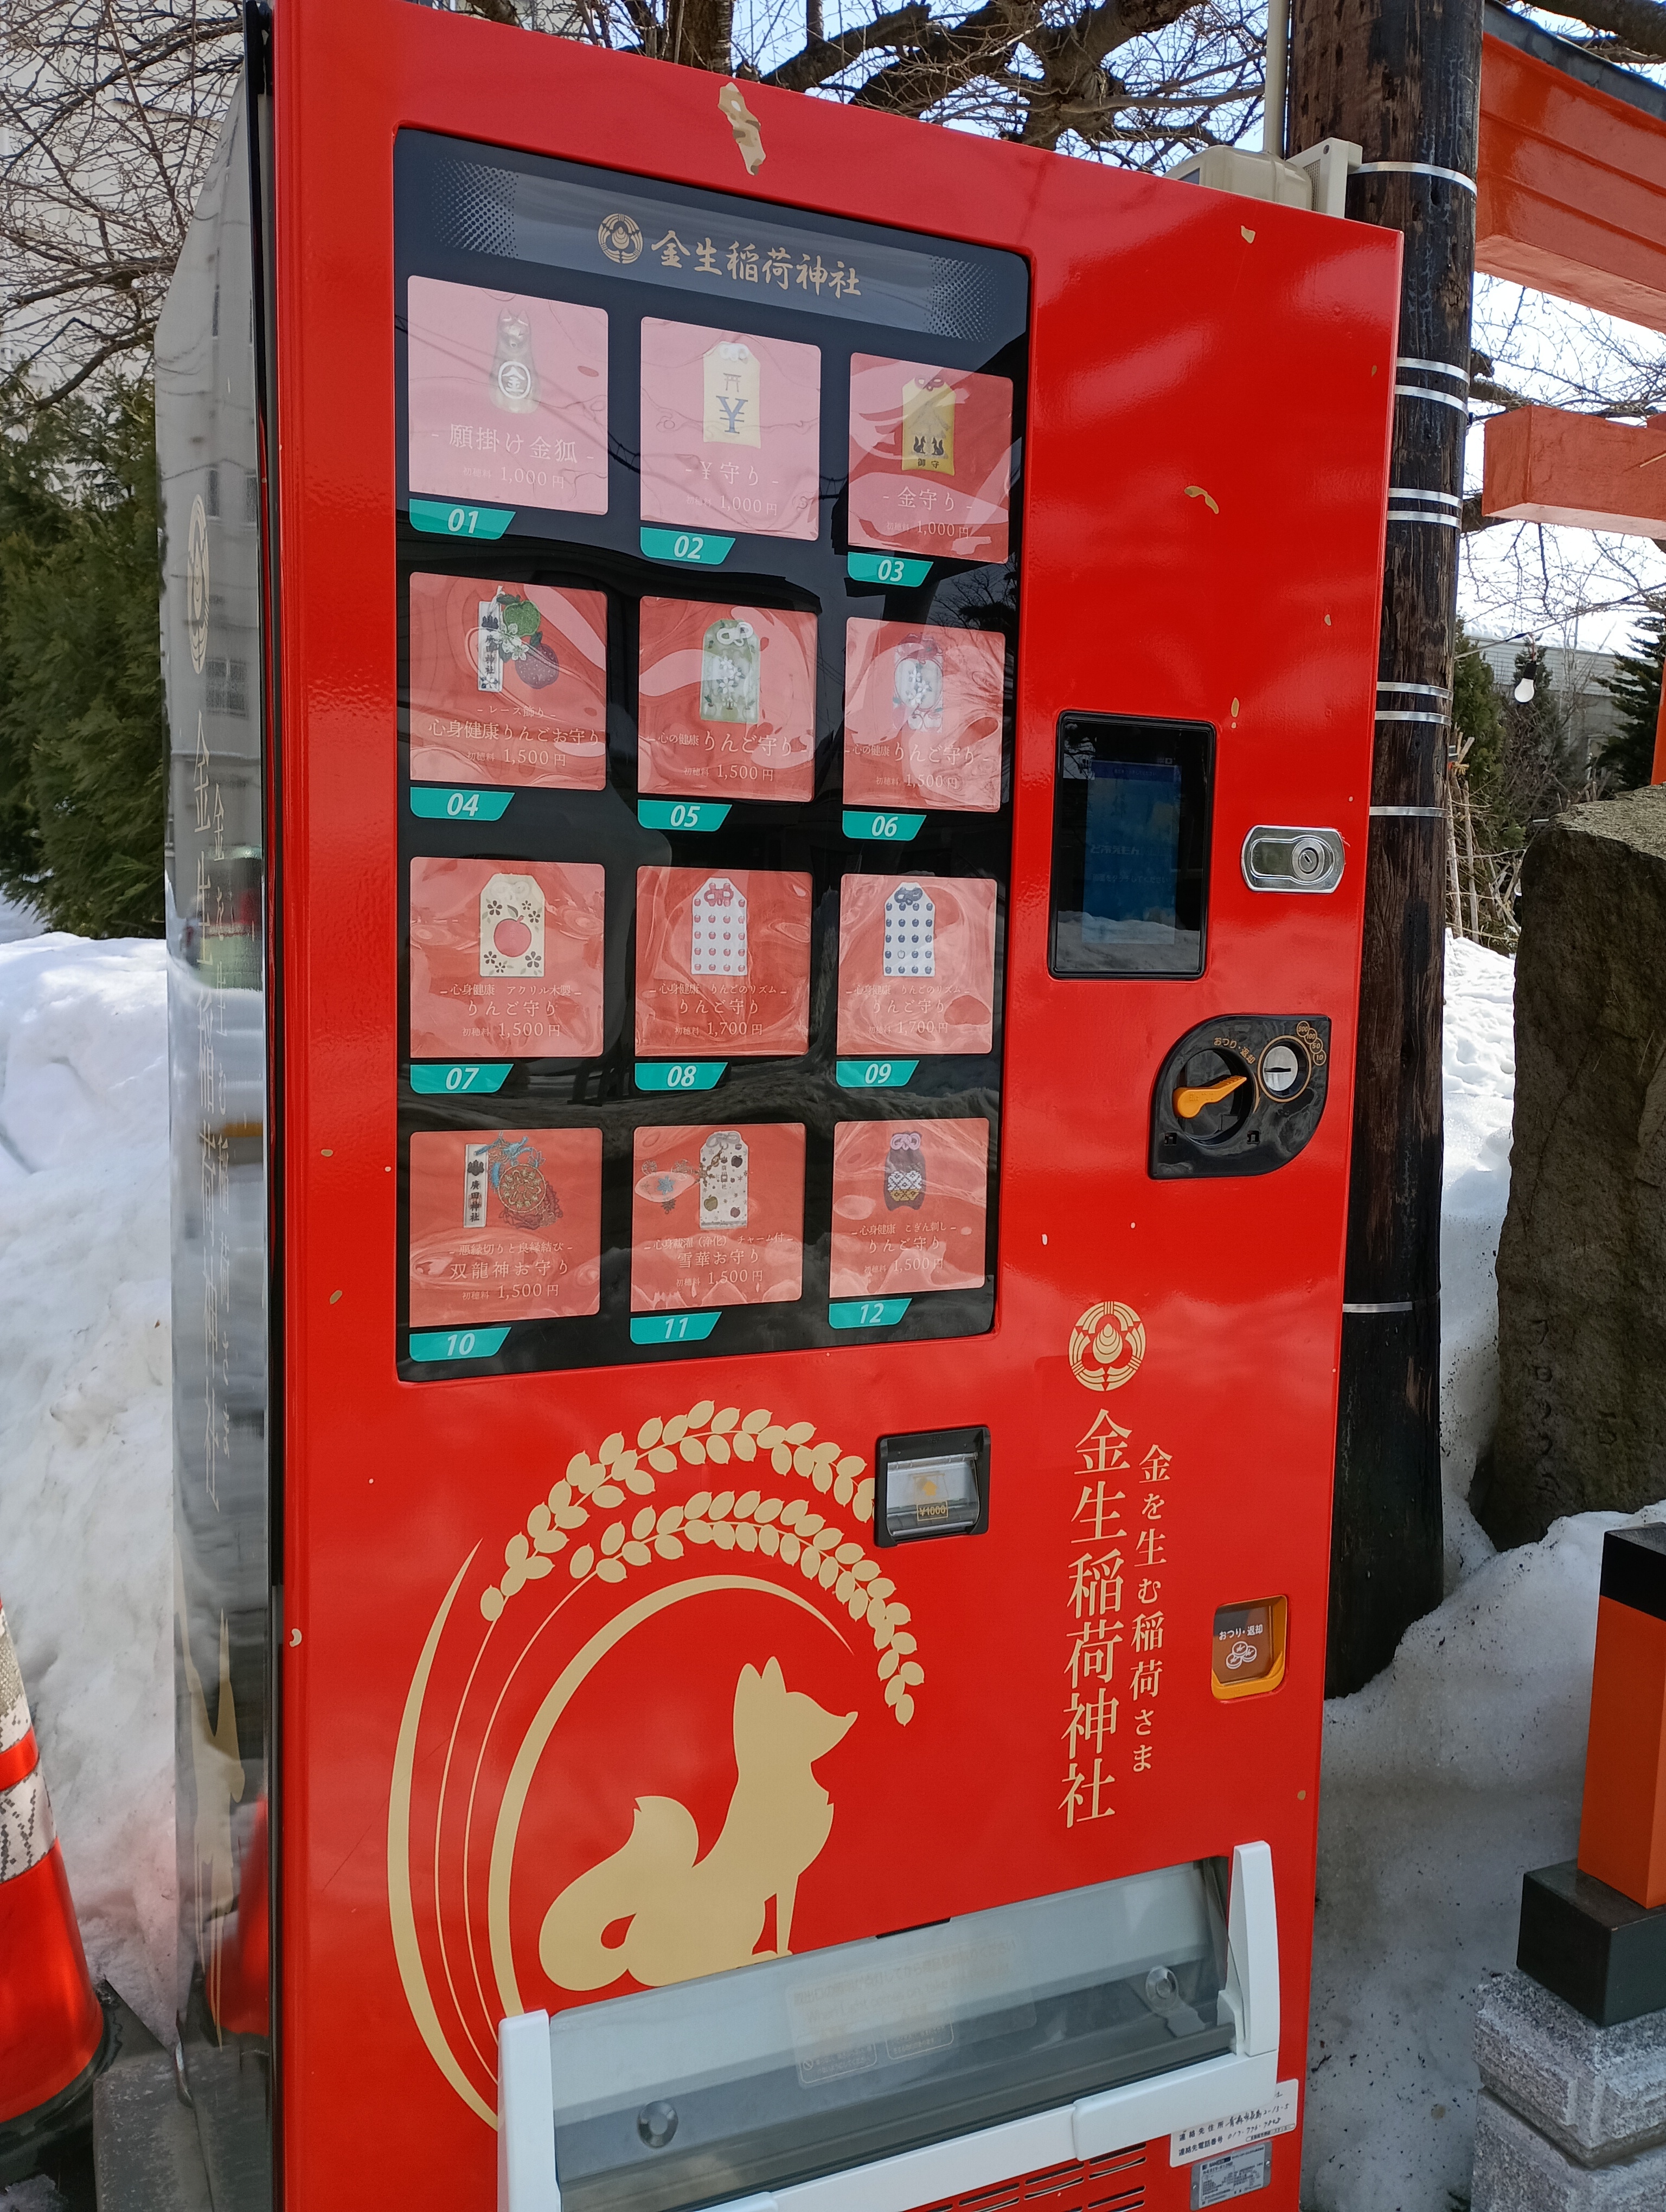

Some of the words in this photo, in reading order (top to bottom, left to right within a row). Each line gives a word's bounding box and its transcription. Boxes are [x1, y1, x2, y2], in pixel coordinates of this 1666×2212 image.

[651, 230, 861, 299] 金生稲荷神社
[502, 366, 524, 393] 金
[449, 423, 577, 463] 願掛け金狐
[898, 486, 954, 511] 金守り
[448, 509, 479, 533] 01
[674, 535, 704, 559] 02
[878, 560, 905, 582] 03
[447, 793, 479, 816] 04
[670, 805, 701, 827] 05
[872, 816, 899, 837] 06
[468, 1001, 555, 1017] りんご守り
[680, 999, 758, 1014] りんご守り
[446, 1068, 480, 1090] 07
[667, 1066, 697, 1087] 08
[865, 1063, 892, 1084] 09
[870, 1236, 939, 1253] りんご守り
[451, 1259, 568, 1280] 双龍神お守り
[677, 1249, 759, 1268] 雪華お守り
[860, 1303, 884, 1324] 12
[665, 1317, 688, 1339] 11
[446, 1333, 475, 1356] 10
[919, 1506, 946, 1516] ¥1000
[1058, 1408, 1132, 1828] 金生稲荷神社
[1129, 1444, 1173, 1772] 金を生む稲荷さま
[1219, 1624, 1263, 1641] おつり・返却
